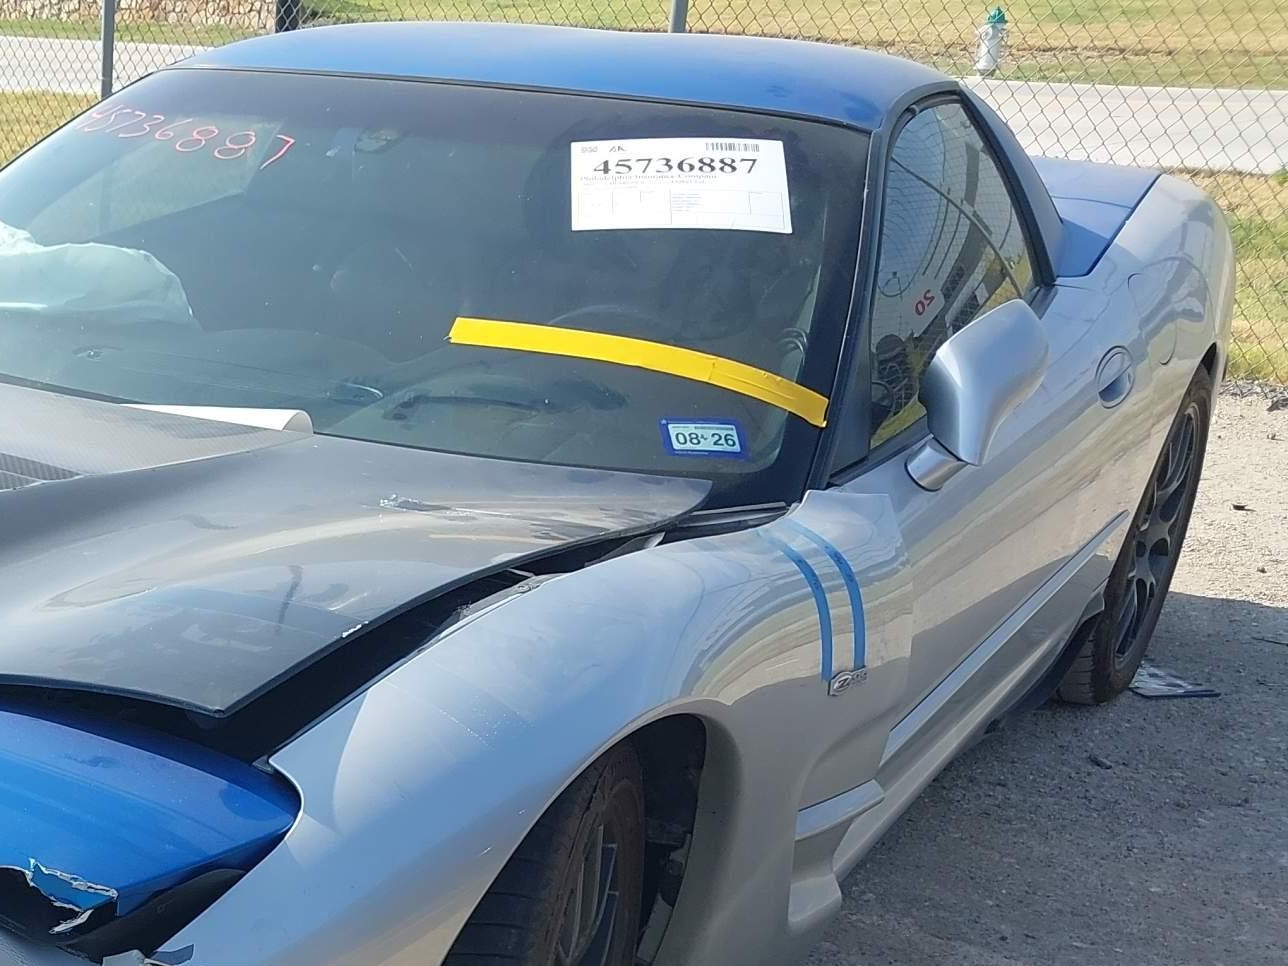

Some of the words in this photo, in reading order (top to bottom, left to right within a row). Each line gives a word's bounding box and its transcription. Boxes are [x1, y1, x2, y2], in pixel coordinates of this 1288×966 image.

[593, 157, 758, 175] 45736887
[675, 432, 701, 446] 08
[710, 432, 736, 447] 26
